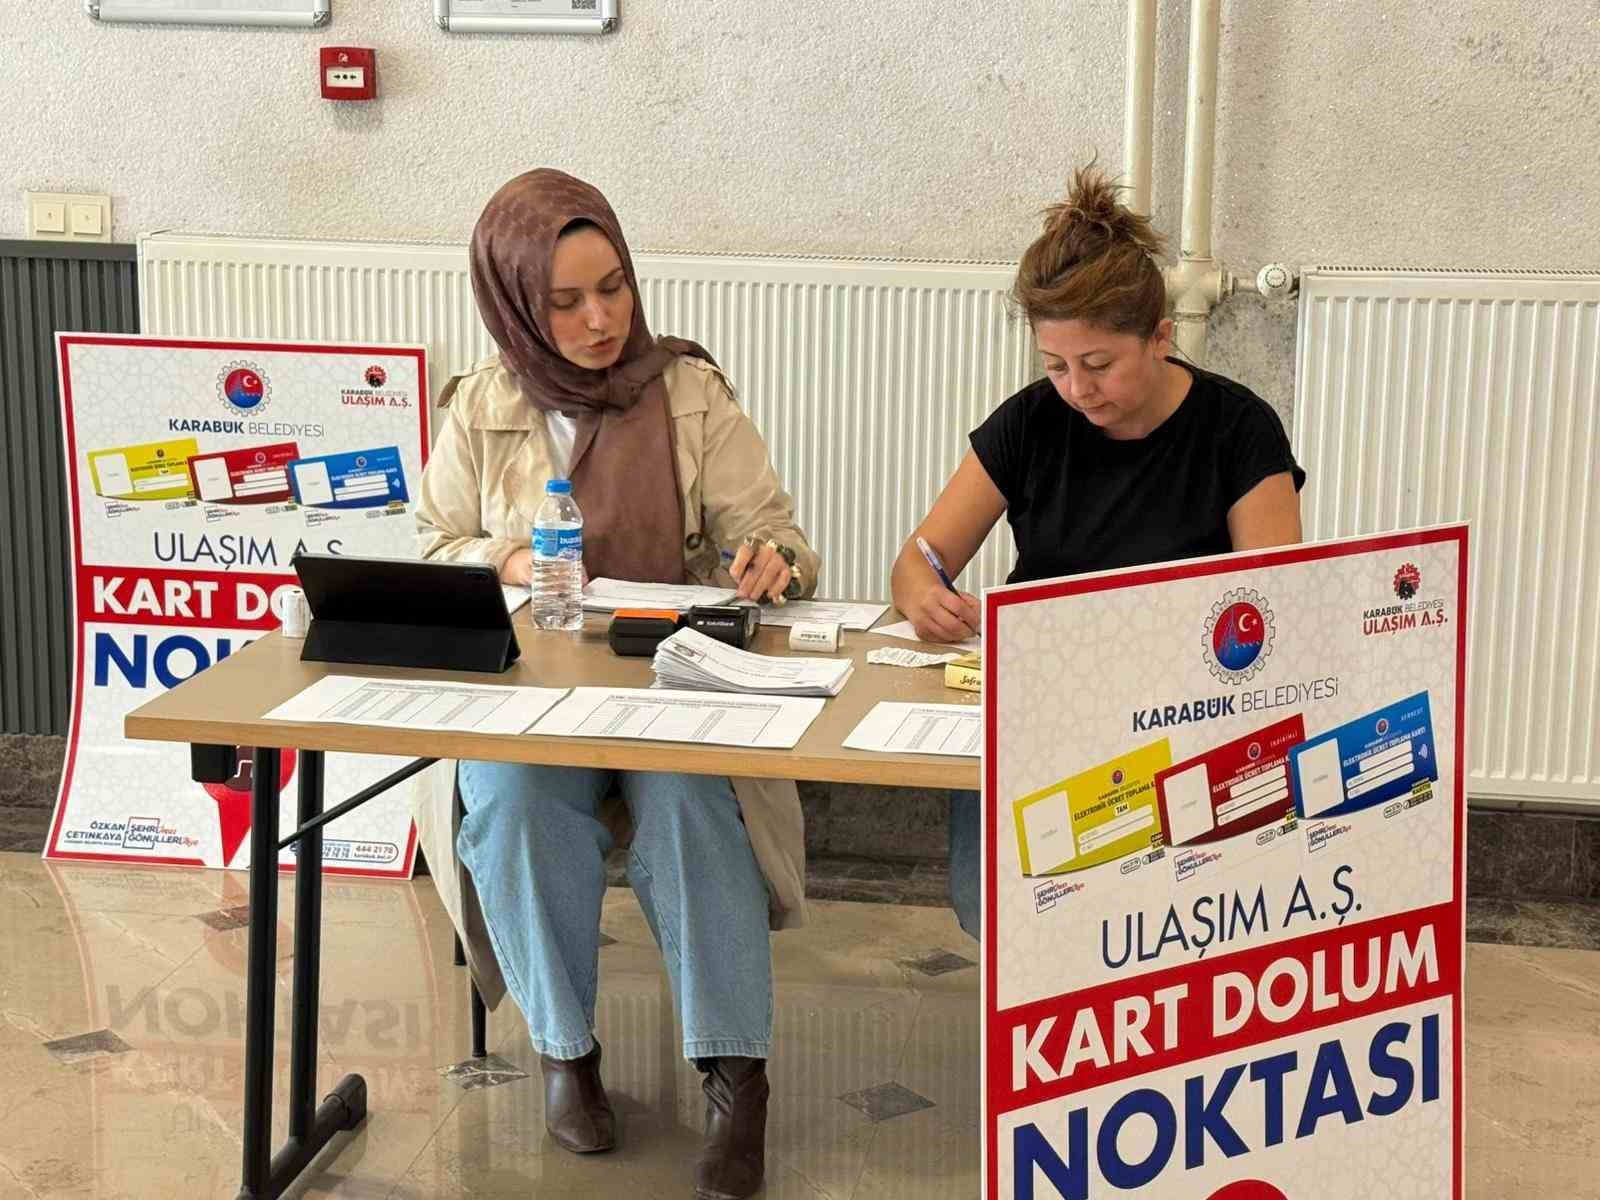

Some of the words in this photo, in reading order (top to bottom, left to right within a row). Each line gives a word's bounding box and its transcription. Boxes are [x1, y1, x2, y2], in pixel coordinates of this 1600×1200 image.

[342, 395, 385, 407] ULAŞIM
[169, 418, 244, 434] KARABÜK
[249, 421, 325, 437] BELEDİYESİ
[154, 532, 277, 570] ULAŞIM
[93, 577, 219, 617] KART
[1363, 605, 1403, 620] KARABÜK
[1363, 613, 1416, 635] ULAŞIM
[1421, 608, 1448, 627] A.Ş.
[1132, 693, 1236, 732] KARABÜK
[1241, 677, 1339, 713] BELEDİYESİ
[90, 820, 126, 830] ÖZKAN
[1102, 883, 1269, 969] ULAŞIM
[1283, 865, 1362, 926] A.Ş.
[1012, 983, 1189, 1092] KART
[1212, 924, 1440, 1039] DOLUM
[1013, 1013, 1440, 1200] NOKTASI
